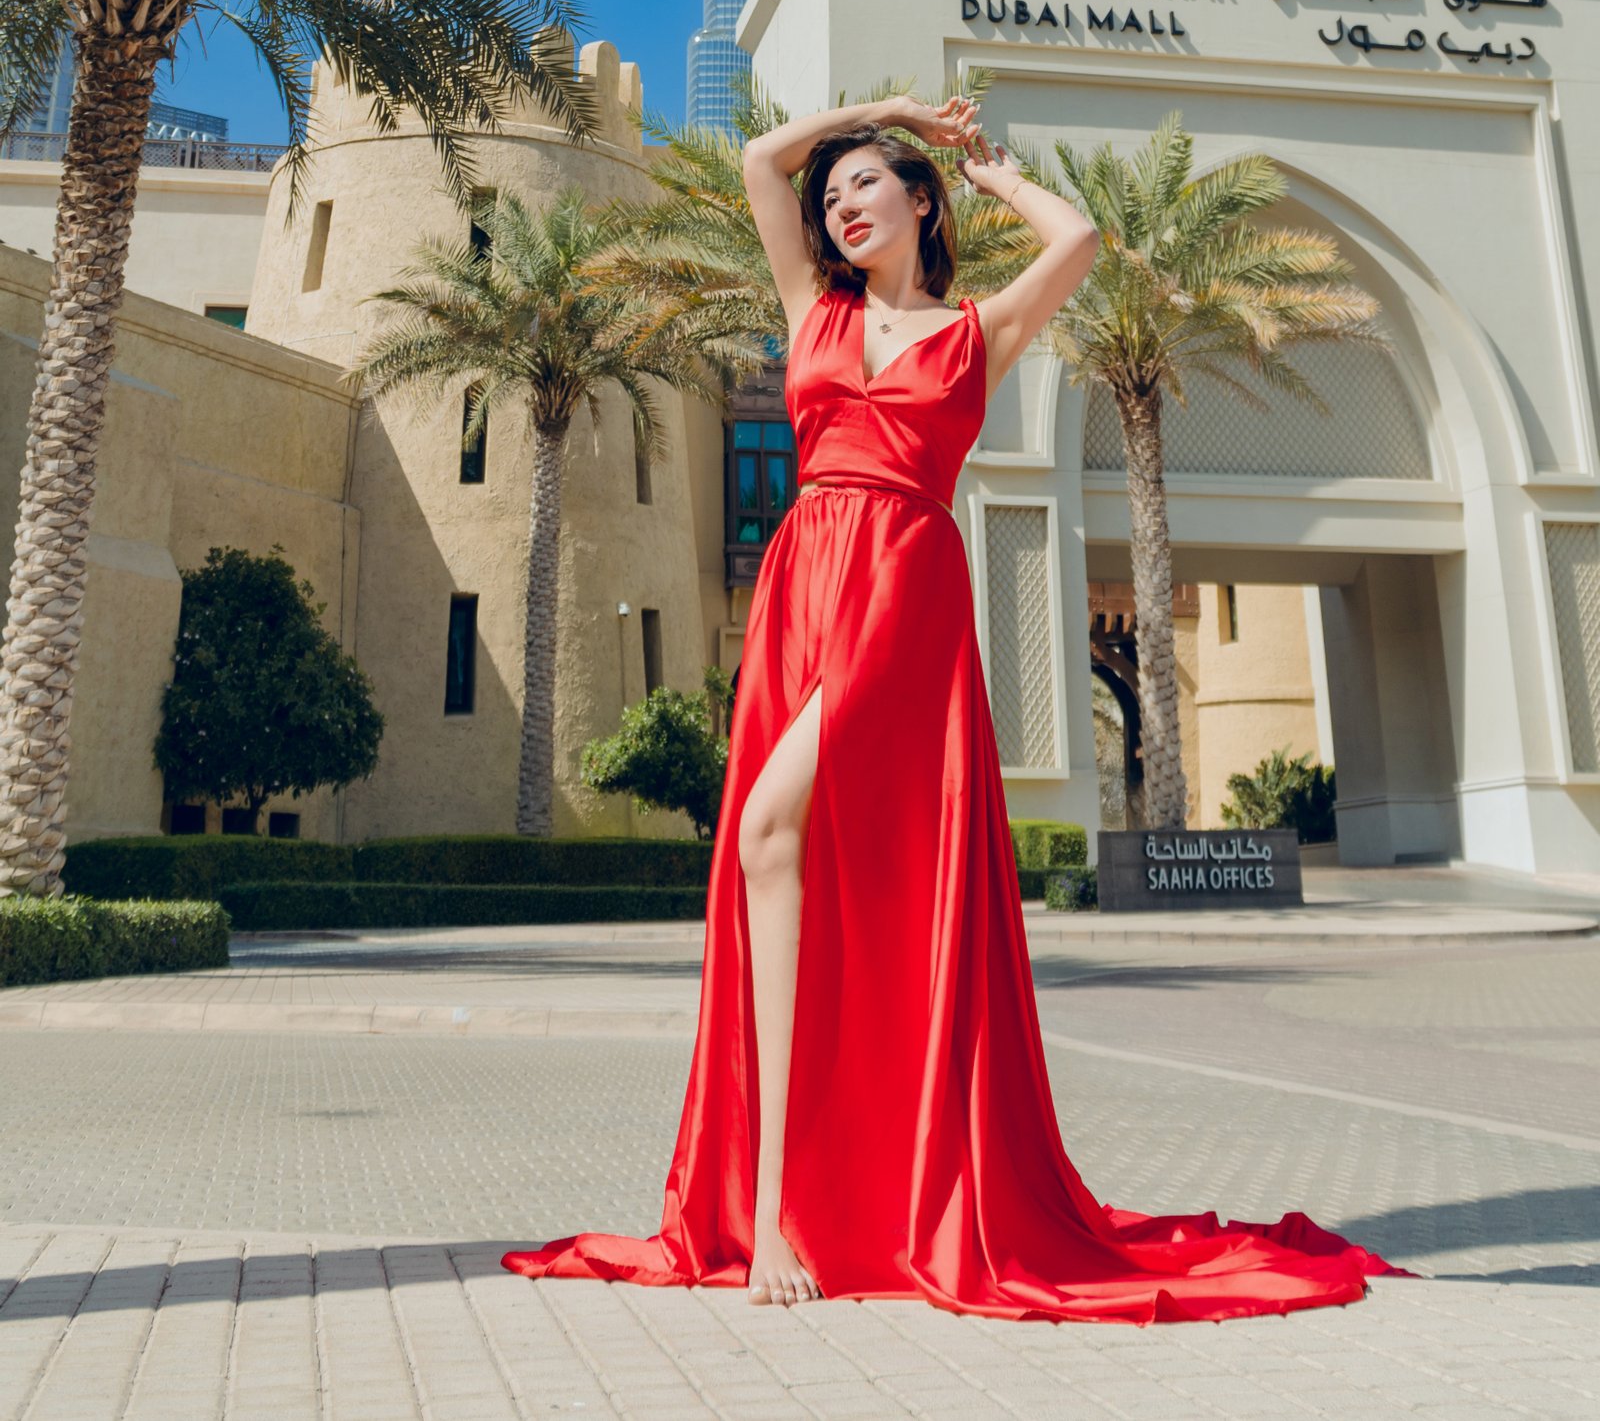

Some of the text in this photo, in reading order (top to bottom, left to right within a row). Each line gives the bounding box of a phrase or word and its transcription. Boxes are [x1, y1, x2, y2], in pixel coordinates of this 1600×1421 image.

[1087, 4, 1185, 36] MALL
[1318, 16, 1536, 65] دبي مول
[1146, 835, 1272, 864] مكاتب الساحة
[1148, 866, 1274, 890] SAAHA OFFICES
